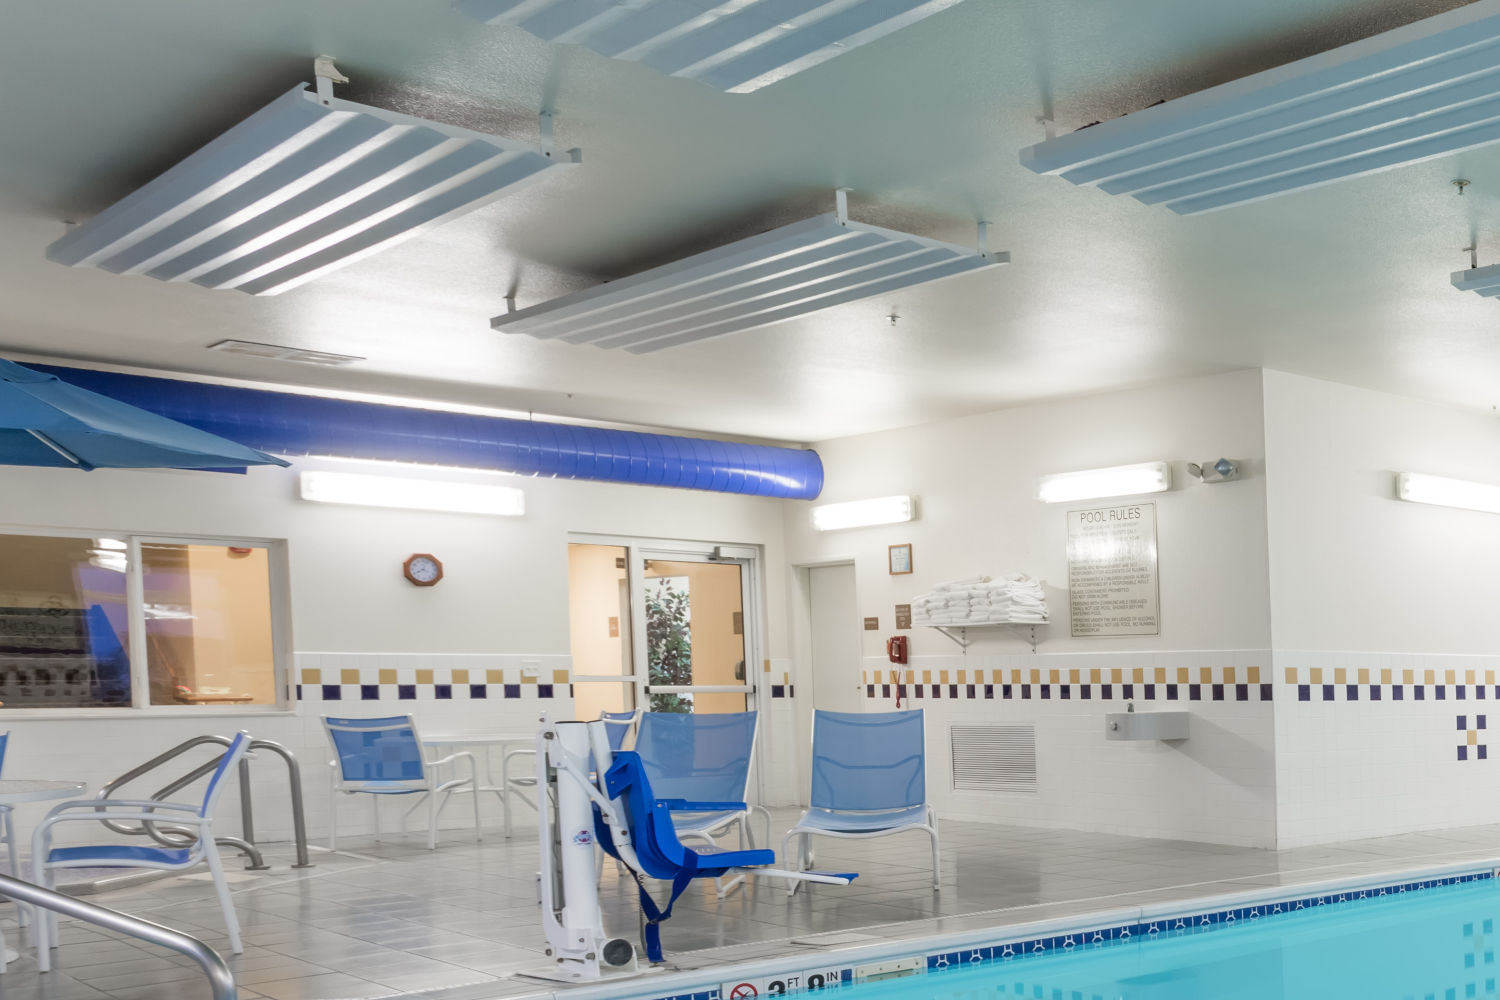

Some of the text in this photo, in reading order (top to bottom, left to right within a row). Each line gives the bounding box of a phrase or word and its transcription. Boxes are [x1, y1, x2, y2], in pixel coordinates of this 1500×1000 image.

[1080, 507, 1141, 523] POOL RULES
[787, 977, 800, 989] FT
[826, 971, 838, 982] IN
